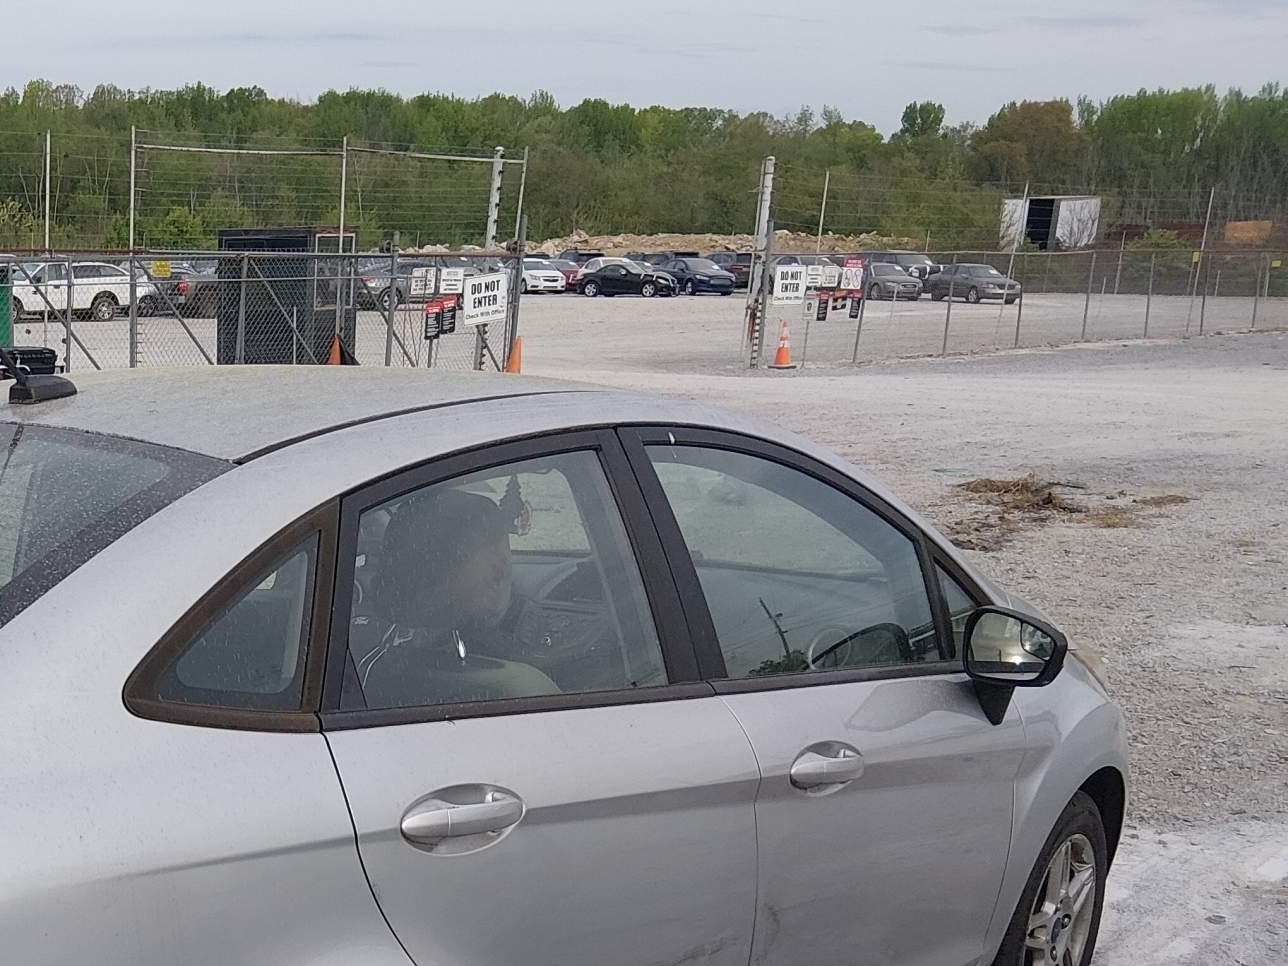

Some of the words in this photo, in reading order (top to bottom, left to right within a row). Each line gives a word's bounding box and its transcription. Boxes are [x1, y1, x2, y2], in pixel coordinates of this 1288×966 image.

[781, 271, 789, 280] DO
[791, 271, 802, 280] NOT
[471, 283, 482, 295] DO
[484, 280, 500, 293] NOT
[781, 283, 800, 292] ENTER
[473, 294, 498, 308] ENTER
